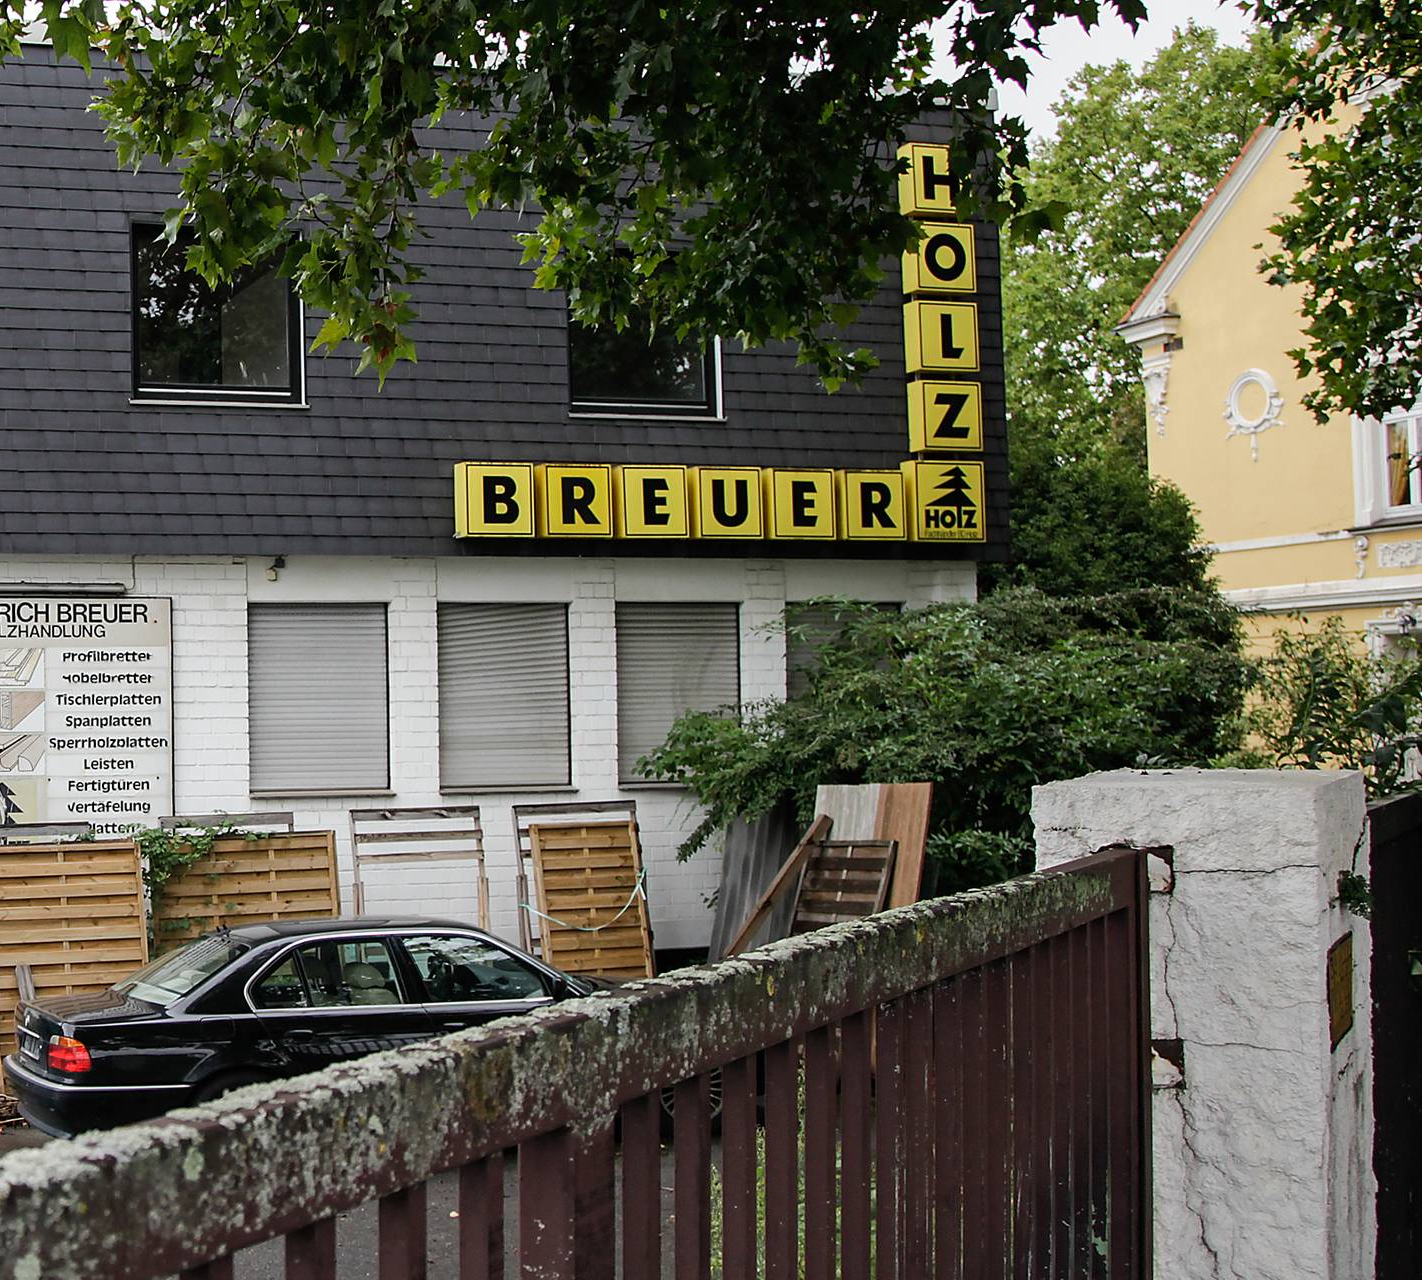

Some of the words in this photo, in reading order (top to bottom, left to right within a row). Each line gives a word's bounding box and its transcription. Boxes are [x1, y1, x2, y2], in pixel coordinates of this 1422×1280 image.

[922, 155, 970, 440] HOLZ
[483, 475, 898, 529] BREUER
[925, 508, 978, 529] HOLZ
[57, 603, 148, 623] BREUER
[62, 650, 153, 662] Profilbretter
[55, 693, 162, 707] Tischlerplatten
[65, 715, 152, 728] Spanplatten
[49, 736, 169, 750] Sperrholzplatten
[84, 757, 135, 770] Leisten
[68, 779, 150, 793] Fertigtüren
